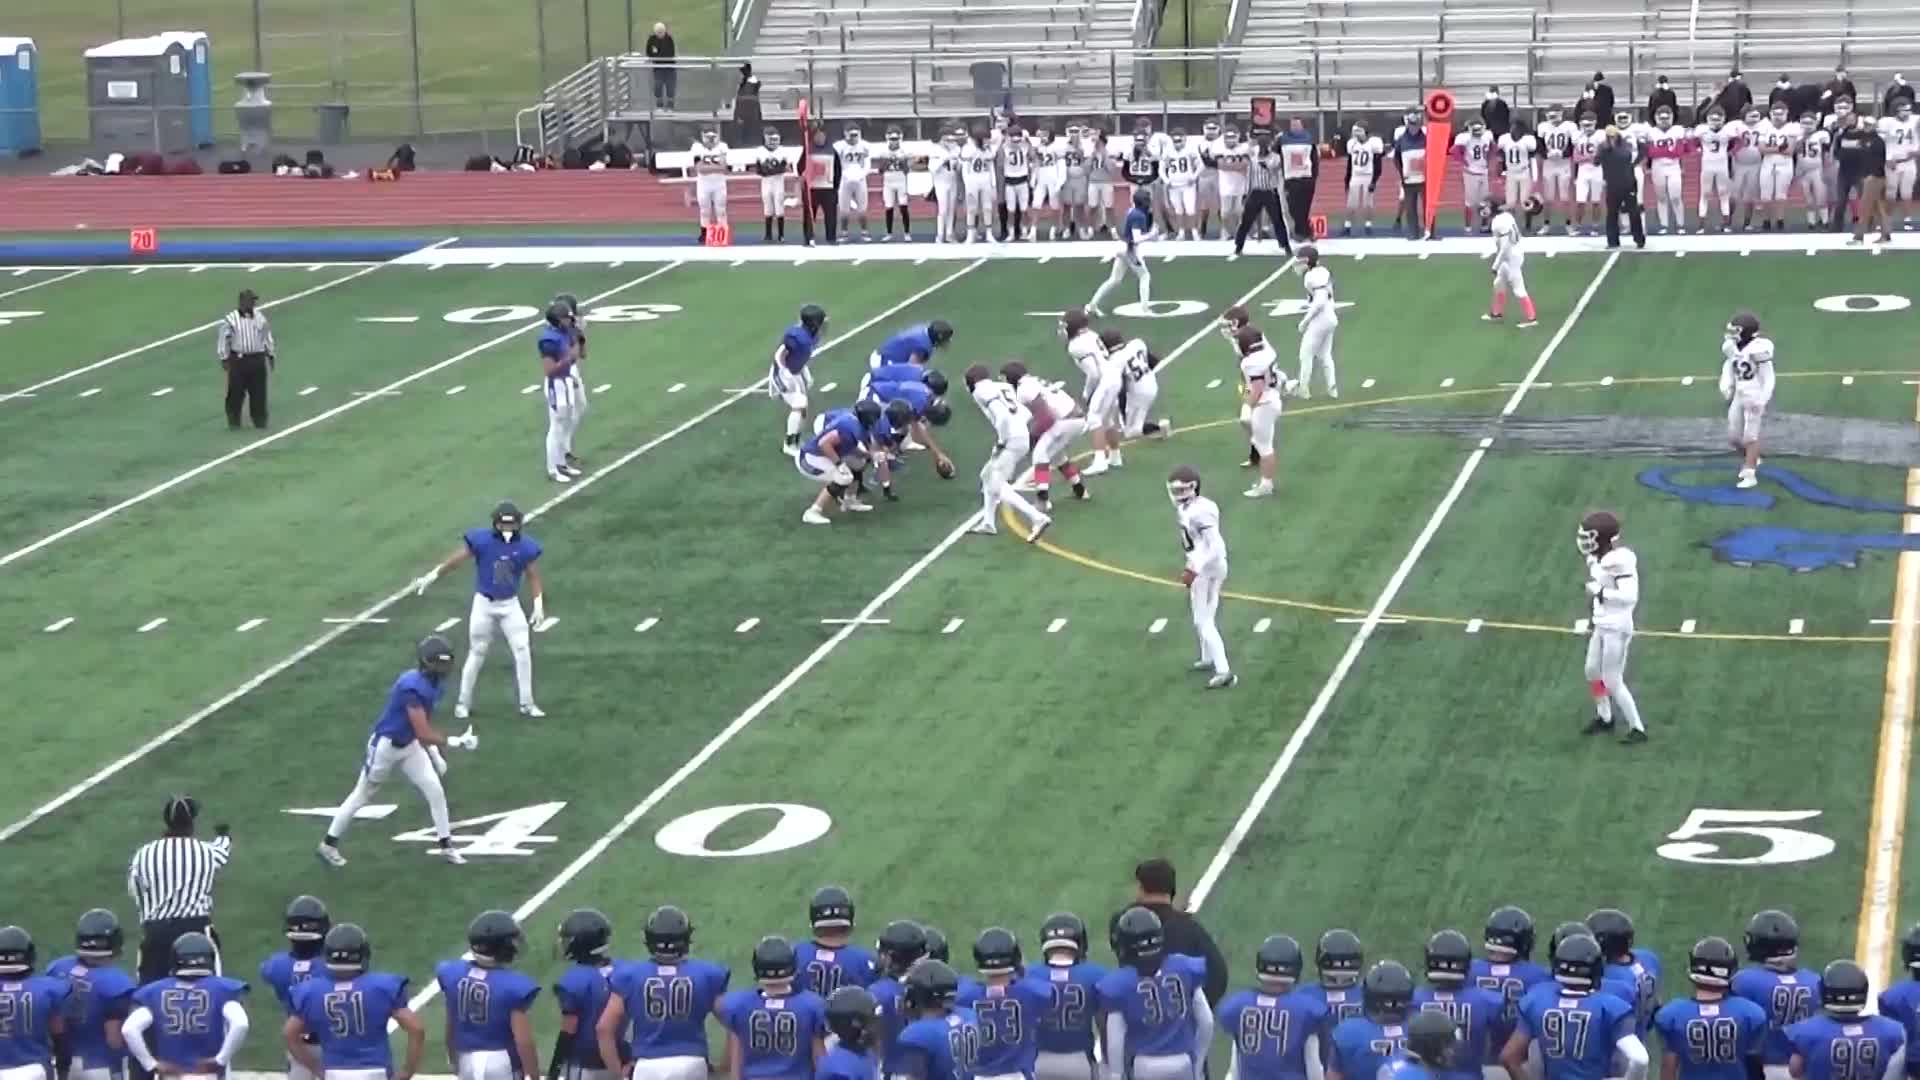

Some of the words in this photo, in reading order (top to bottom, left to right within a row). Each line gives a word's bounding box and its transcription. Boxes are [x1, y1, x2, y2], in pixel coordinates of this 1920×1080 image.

[1352, 150, 1370, 167] 70
[133, 231, 151, 249] 20
[1656, 808, 1836, 865] 5
[161, 989, 210, 1034] 52
[323, 991, 366, 1037] 51
[456, 977, 490, 1025] 19
[643, 976, 694, 1023] 60
[1136, 974, 1188, 1026] 33
[750, 1010, 798, 1057] 68
[1240, 1007, 1290, 1057] 84
[1542, 1008, 1593, 1061] 97
[1686, 1017, 1737, 1064] 98
[1831, 1037, 1880, 1080] 99
